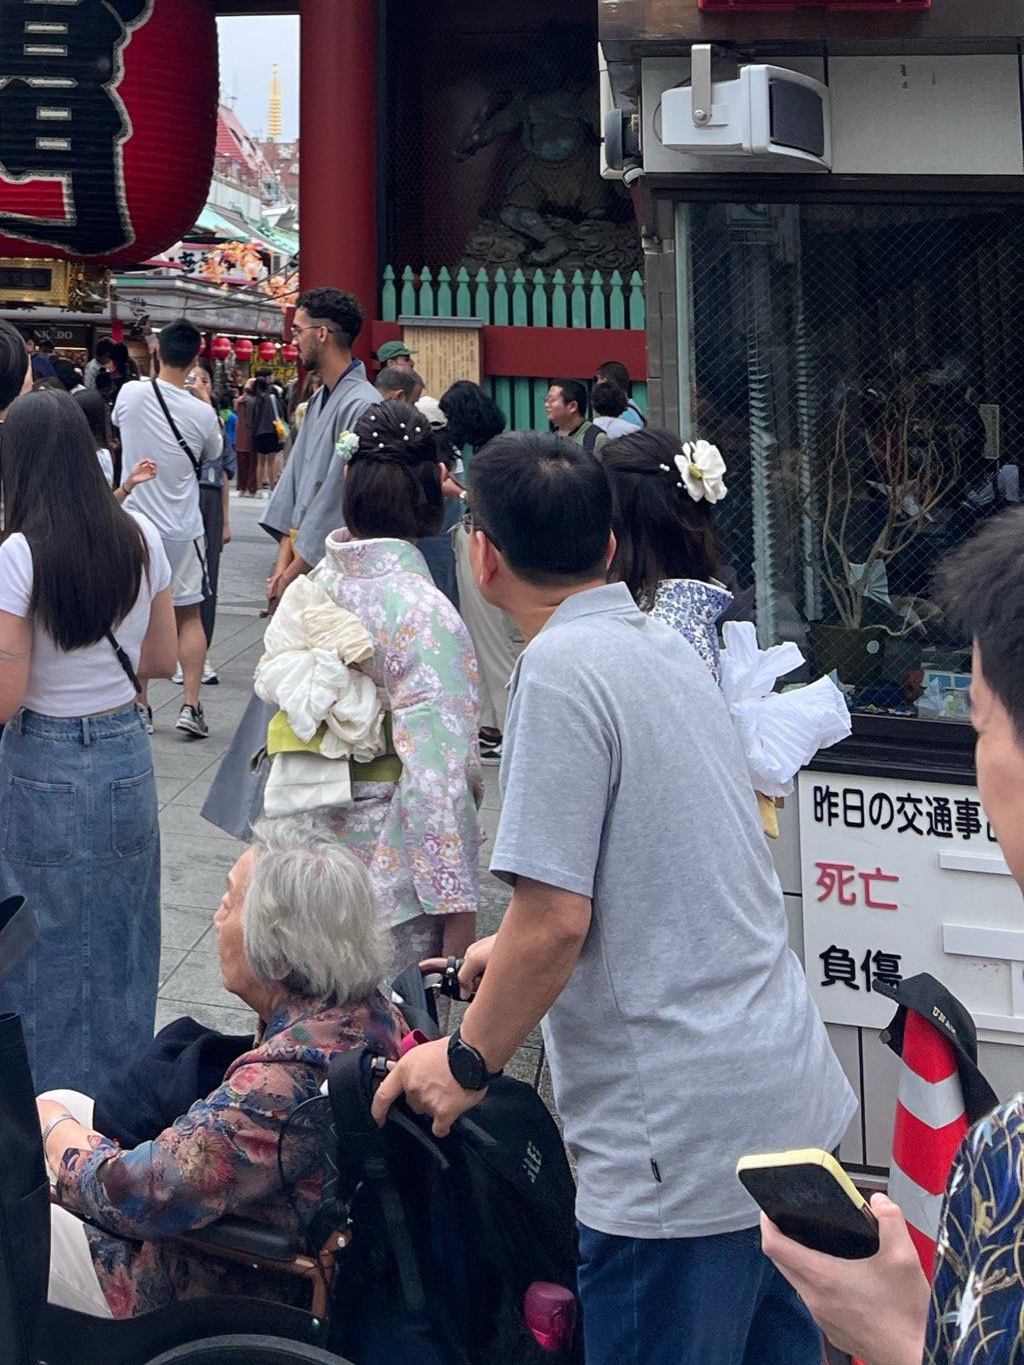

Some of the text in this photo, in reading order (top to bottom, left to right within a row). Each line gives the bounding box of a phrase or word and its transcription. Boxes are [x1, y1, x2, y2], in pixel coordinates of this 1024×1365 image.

[813, 785, 998, 843] 昨日の交通事
[815, 862, 900, 911] 死亡
[819, 944, 903, 992] 負傷
